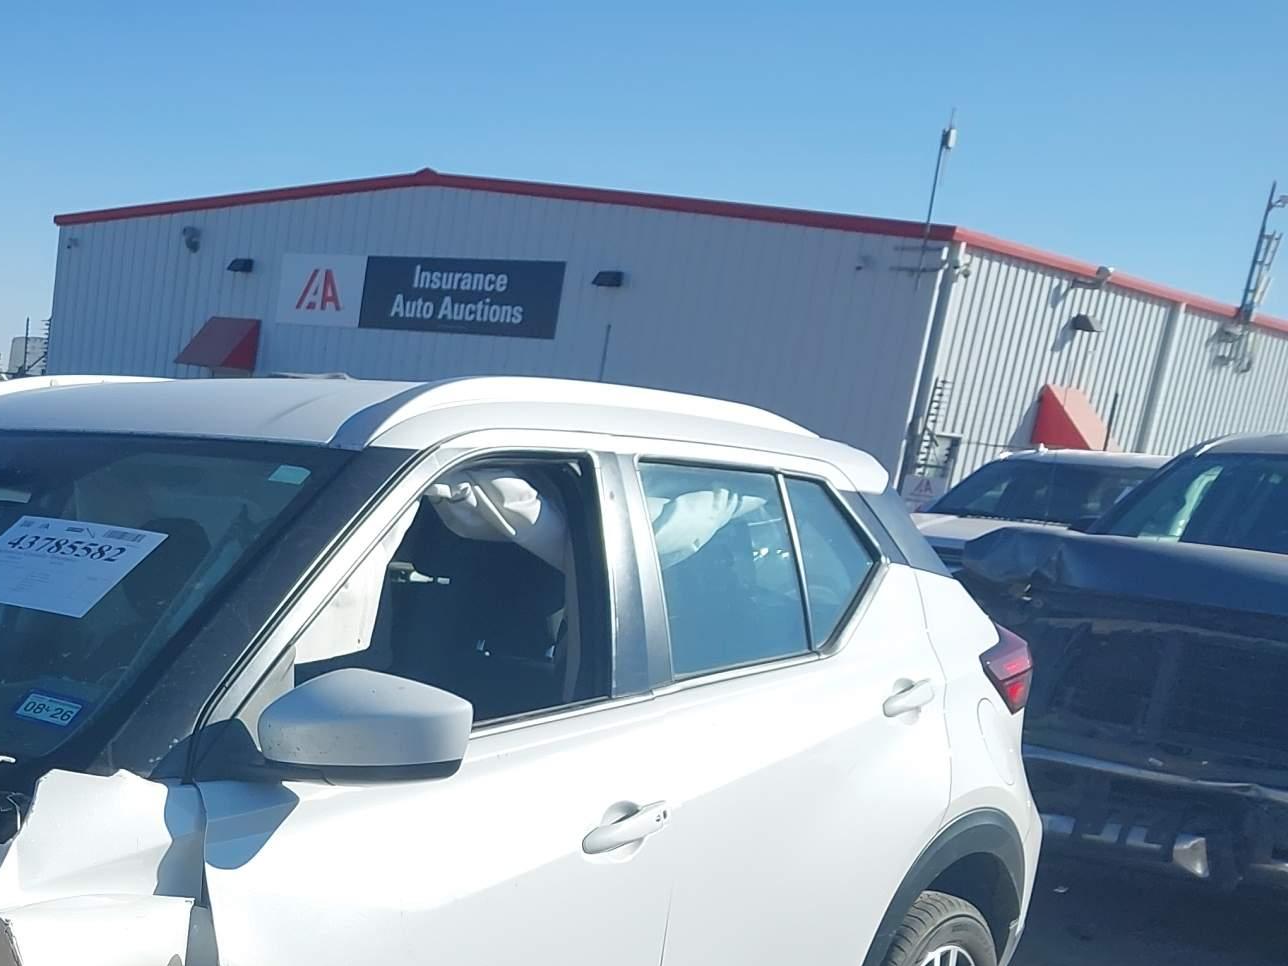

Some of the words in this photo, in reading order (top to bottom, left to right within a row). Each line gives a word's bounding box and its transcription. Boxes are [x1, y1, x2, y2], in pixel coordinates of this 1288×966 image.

[413, 264, 508, 292] Insurance
[390, 294, 434, 319] Auto
[437, 295, 524, 324] Auctions
[8, 533, 127, 562] 43785582
[24, 701, 47, 714] 08
[49, 707, 74, 721] 26
